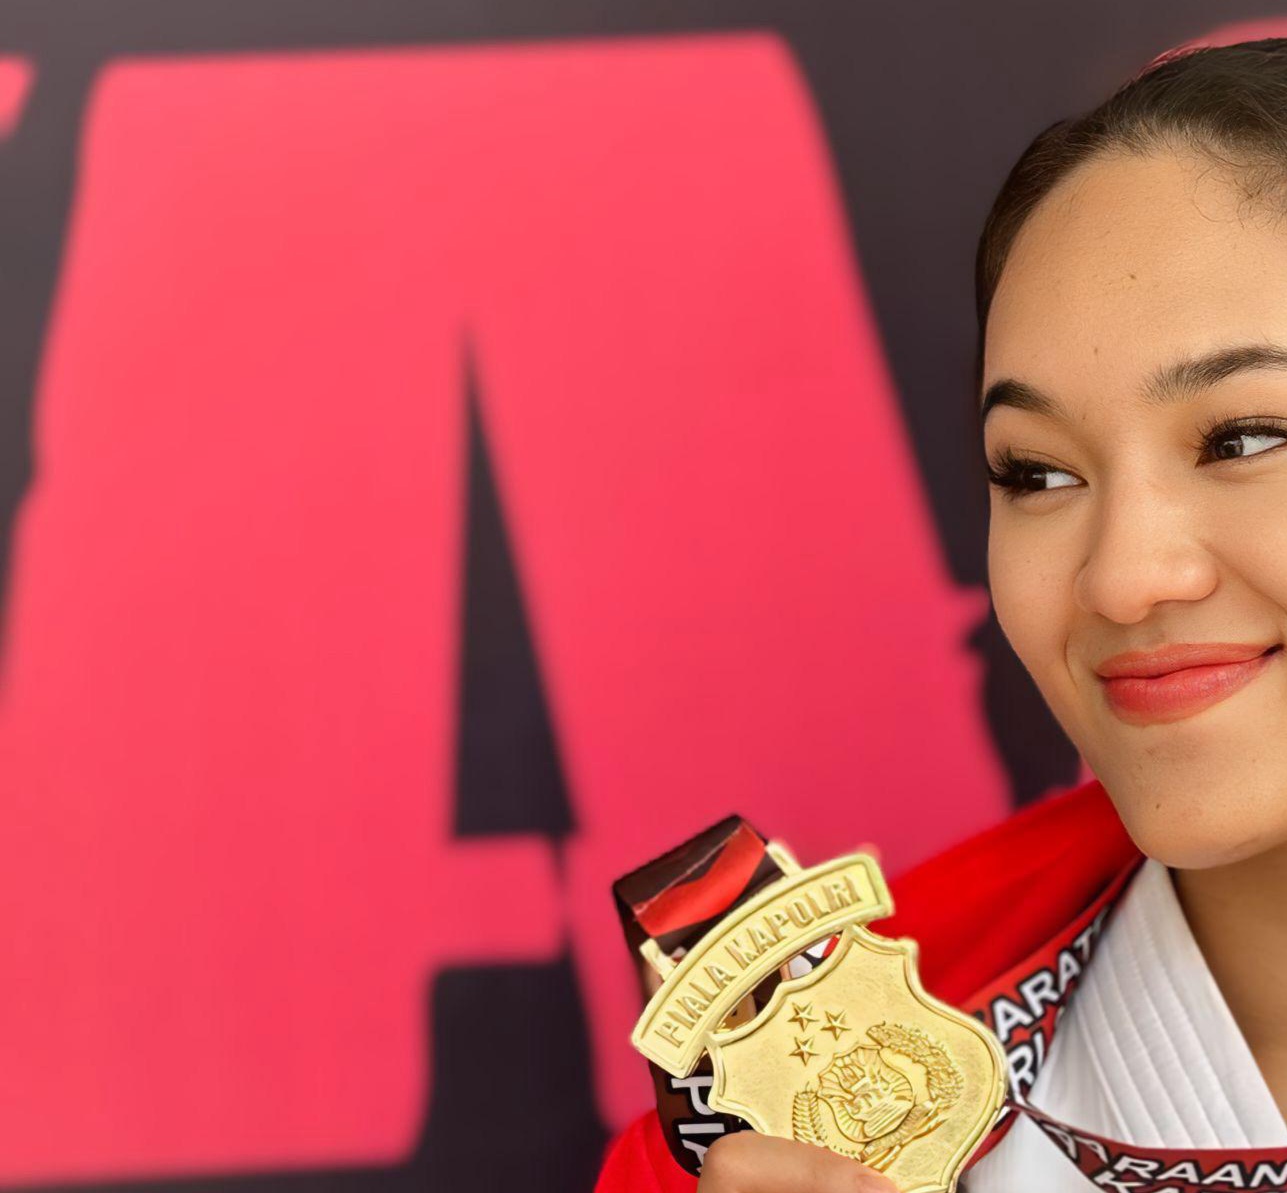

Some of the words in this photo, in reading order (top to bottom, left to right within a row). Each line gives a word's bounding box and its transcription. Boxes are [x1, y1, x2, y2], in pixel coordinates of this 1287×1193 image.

[654, 963, 738, 1048] PIALA
[724, 874, 863, 971] KAPOLRI
[992, 905, 1110, 1043] ARAT
